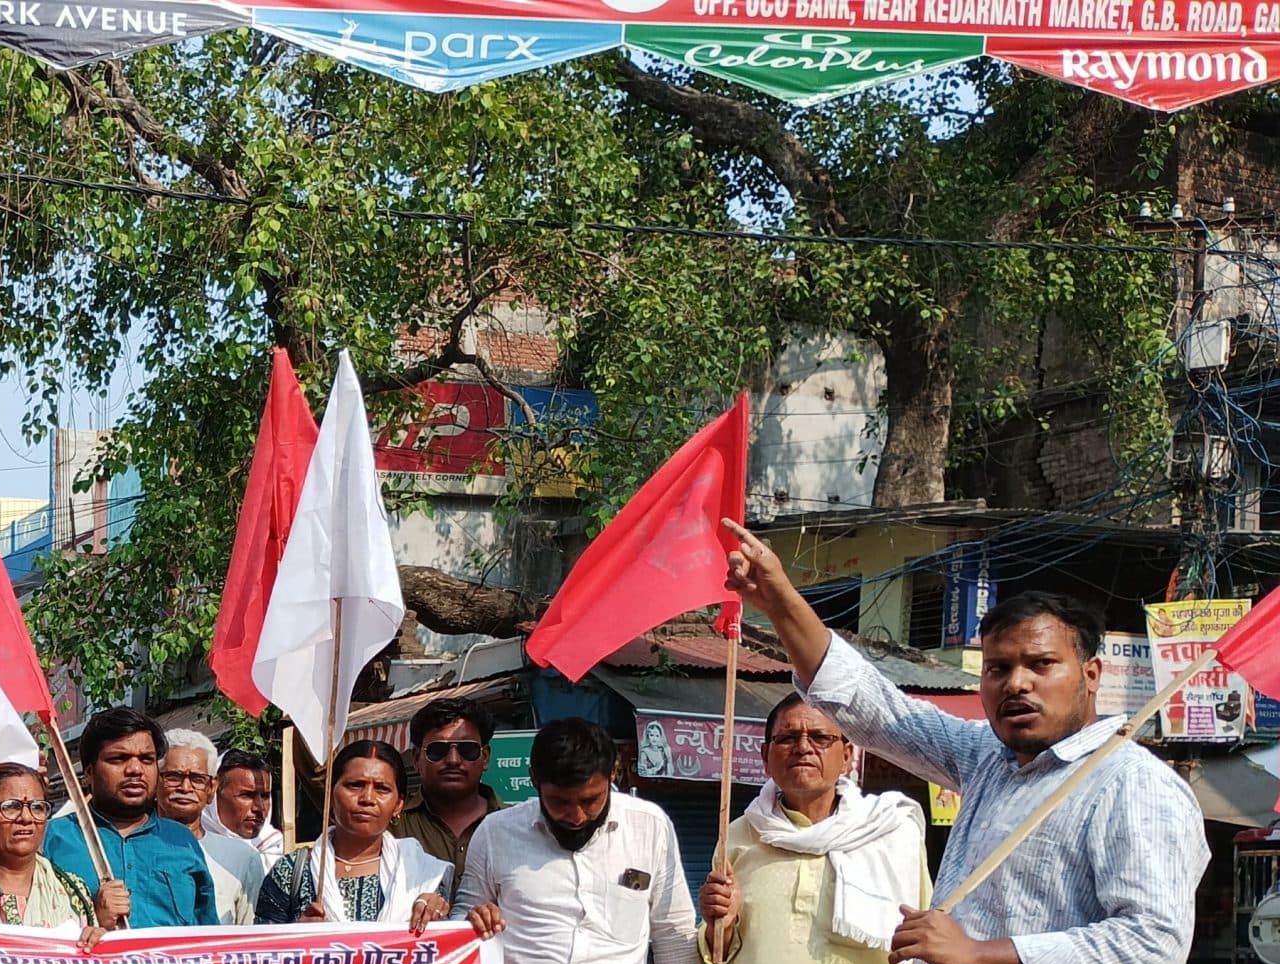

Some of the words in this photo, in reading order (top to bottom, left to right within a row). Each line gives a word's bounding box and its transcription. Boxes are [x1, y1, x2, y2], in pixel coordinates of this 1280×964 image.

[55, 7, 187, 36] AVENUE
[795, 0, 857, 25] BANK,
[863, 0, 917, 22] NEAR
[923, 0, 1043, 27] KEDARNATH
[1048, 0, 1133, 35] MARKET,
[1141, 0, 1179, 32] G.B.
[1186, 1, 1248, 36] ROAD,
[404, 30, 543, 66] parx
[684, 44, 925, 74] ColorPlus
[1058, 46, 1268, 90] Raymond
